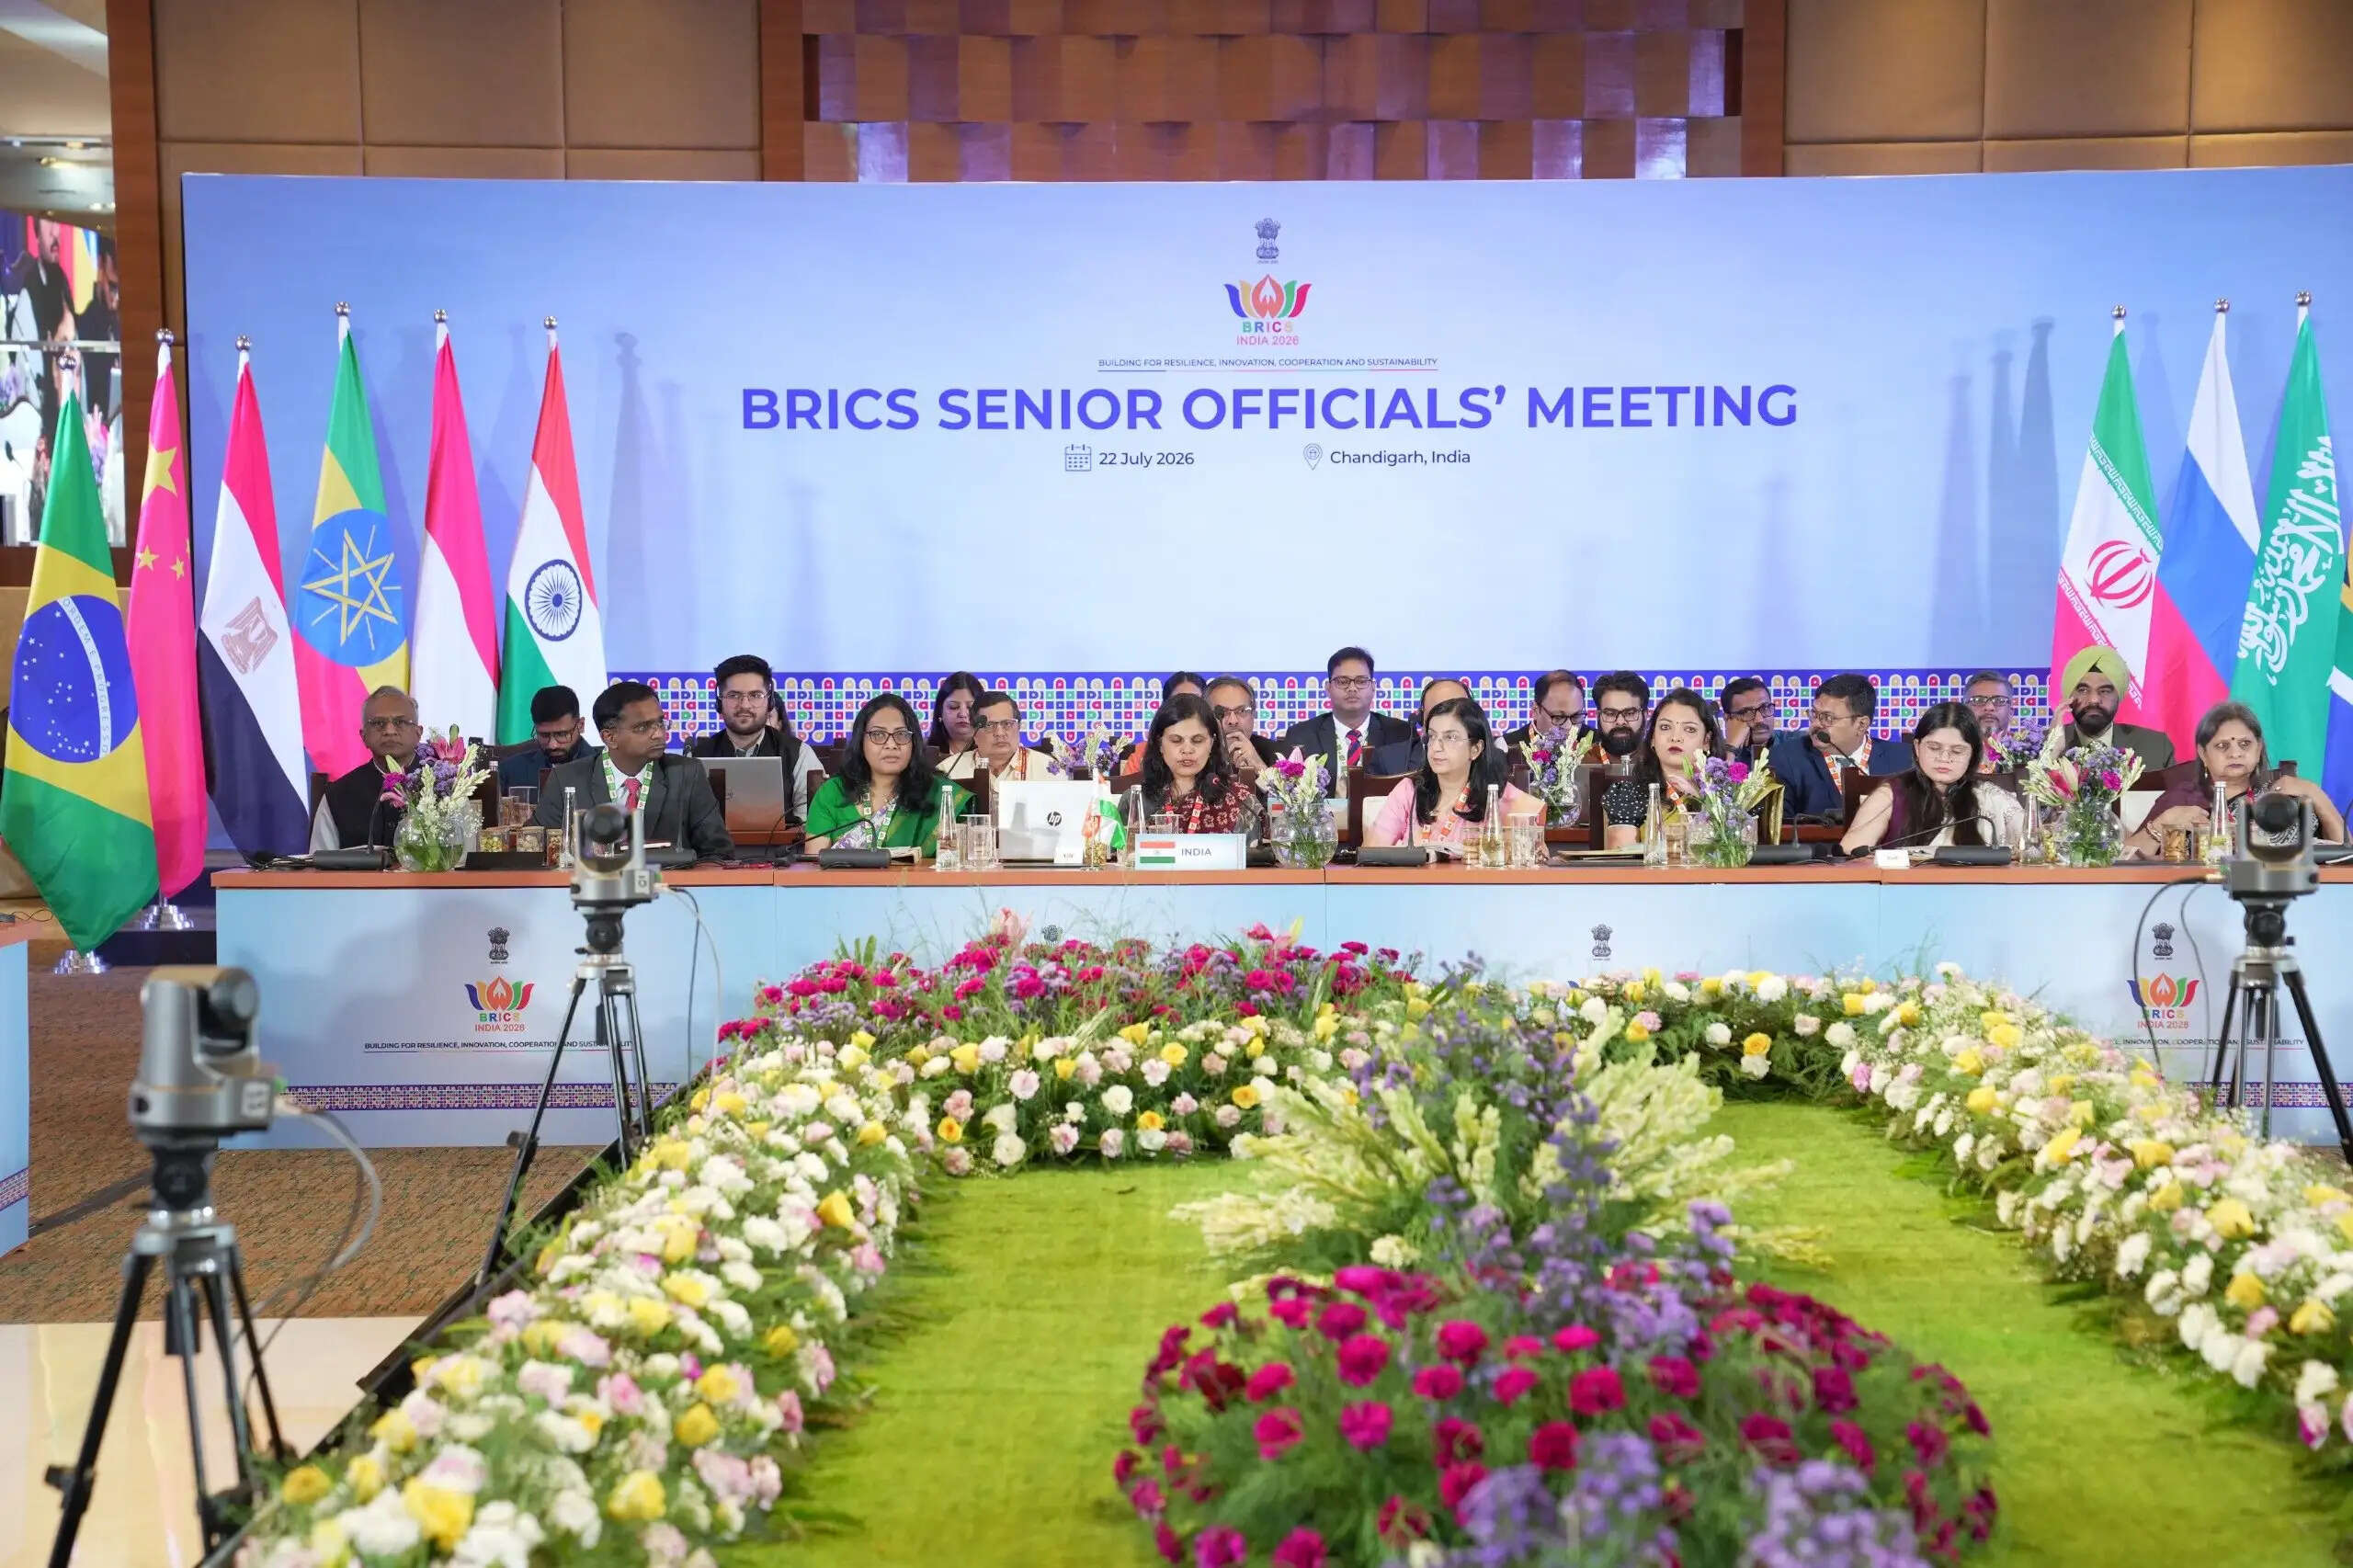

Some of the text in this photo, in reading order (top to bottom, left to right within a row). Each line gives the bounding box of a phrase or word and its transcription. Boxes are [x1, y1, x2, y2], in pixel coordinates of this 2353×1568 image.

[1242, 322, 1293, 333] BRICS
[1236, 335, 1299, 346] INDIA 2026
[1164, 359, 1217, 368] RESILIENCE,
[743, 389, 919, 430] BRICS
[938, 388, 1163, 430] SENIOR
[1528, 384, 1797, 428] MEETING
[1099, 451, 1195, 468] 22 July 2026
[1330, 449, 1471, 466] Chandigarh, India
[1048, 812, 1061, 826] hp
[1181, 847, 1212, 857] INDIA
[479, 1012, 521, 1022] BRICS
[475, 1023, 501, 1032] INDIA
[417, 1041, 460, 1050] RESILIENCE,
